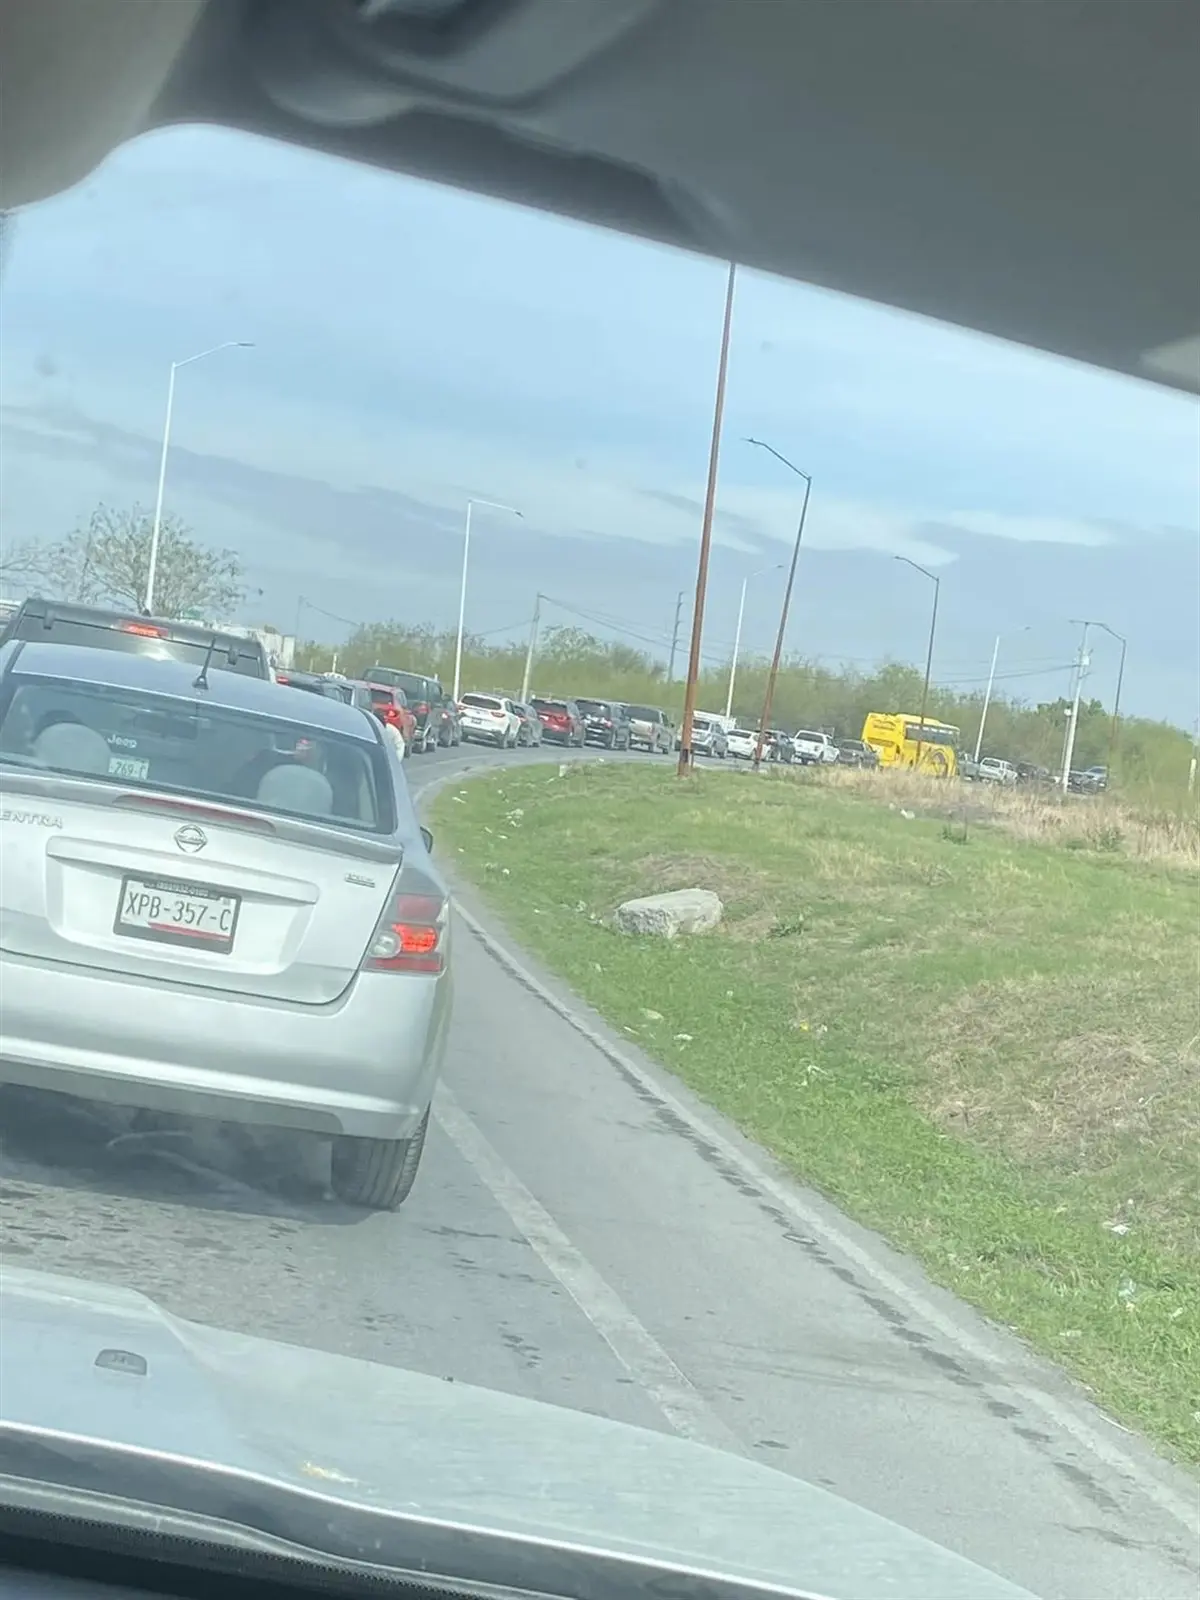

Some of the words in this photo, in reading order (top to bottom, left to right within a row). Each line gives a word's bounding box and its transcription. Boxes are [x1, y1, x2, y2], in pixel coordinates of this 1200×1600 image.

[107, 734, 138, 749] Jeep
[0, 811, 63, 829] ENTRA
[125, 891, 231, 931] XPB-357-C
